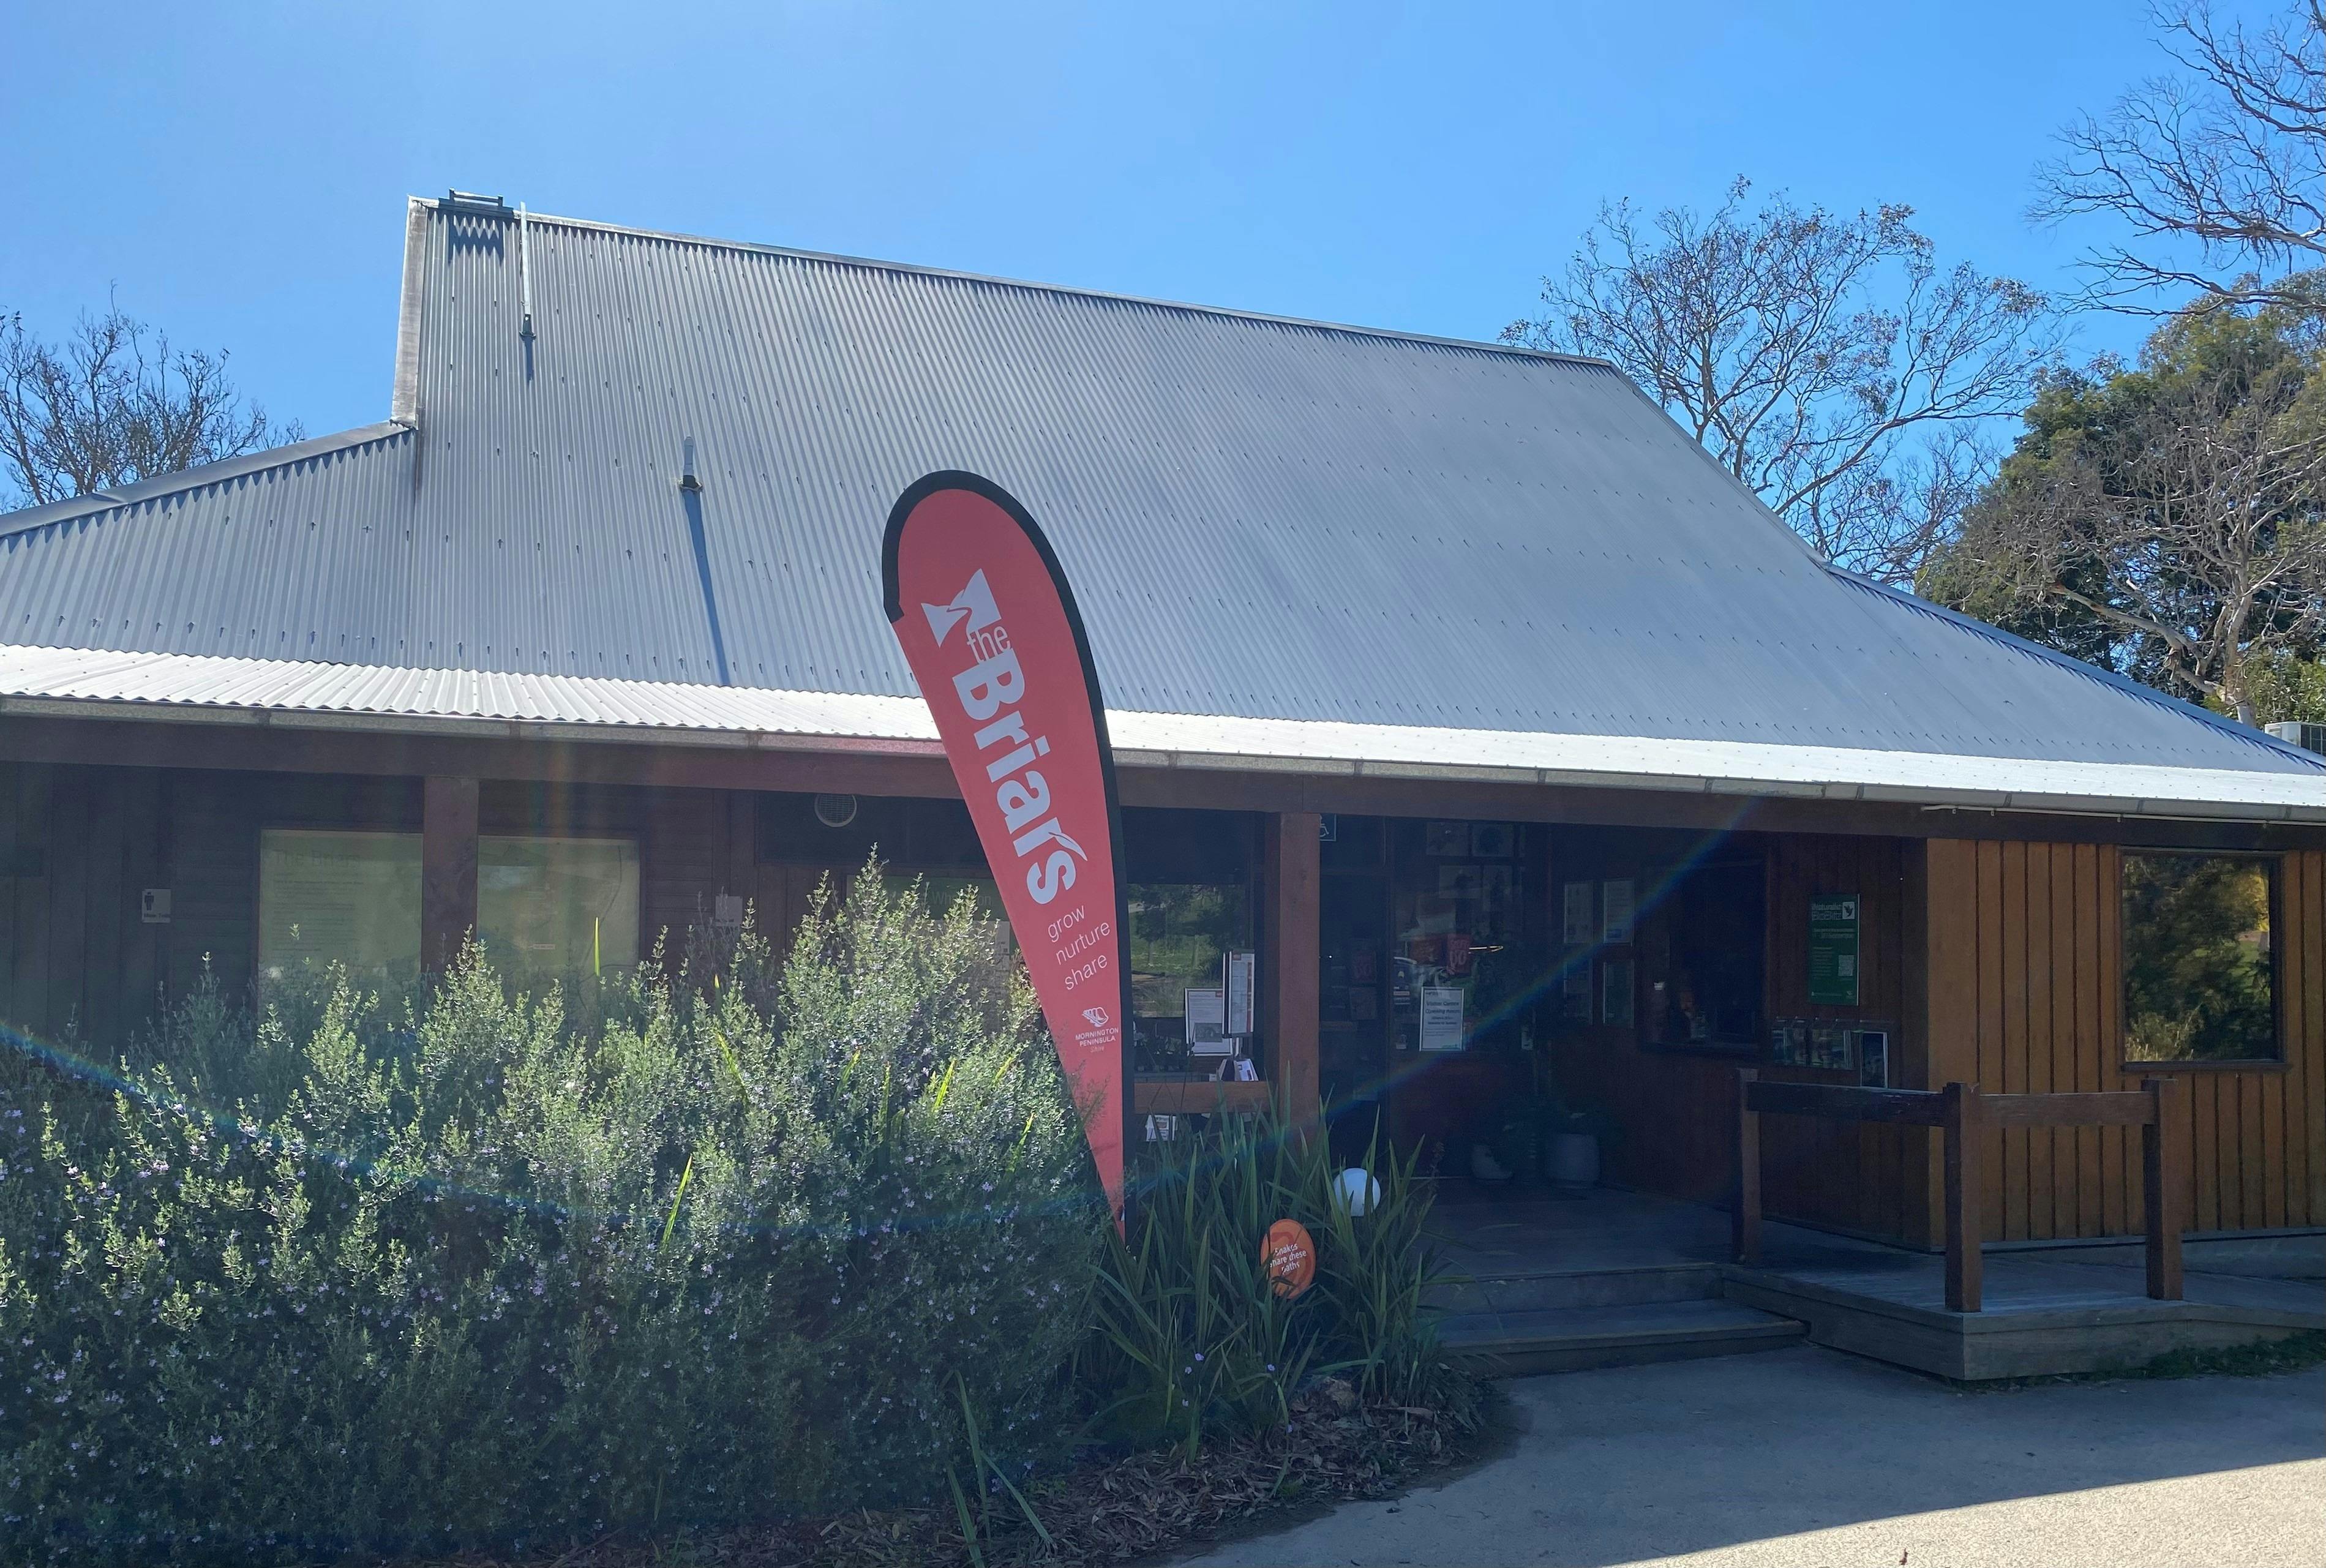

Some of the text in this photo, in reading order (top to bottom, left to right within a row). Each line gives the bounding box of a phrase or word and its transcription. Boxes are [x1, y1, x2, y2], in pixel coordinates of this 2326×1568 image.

[967, 625, 1011, 662] the
[952, 648, 1087, 904] Briars
[1048, 905, 1086, 943] grow
[1056, 922, 1111, 966] nurture
[1064, 955, 1108, 991] share
[1075, 1027, 1119, 1040] MORNINGTON
[1079, 1035, 1116, 1047] PENINSULA
[1274, 1244, 1298, 1256] Snakes
[1289, 1250, 1307, 1261] these
